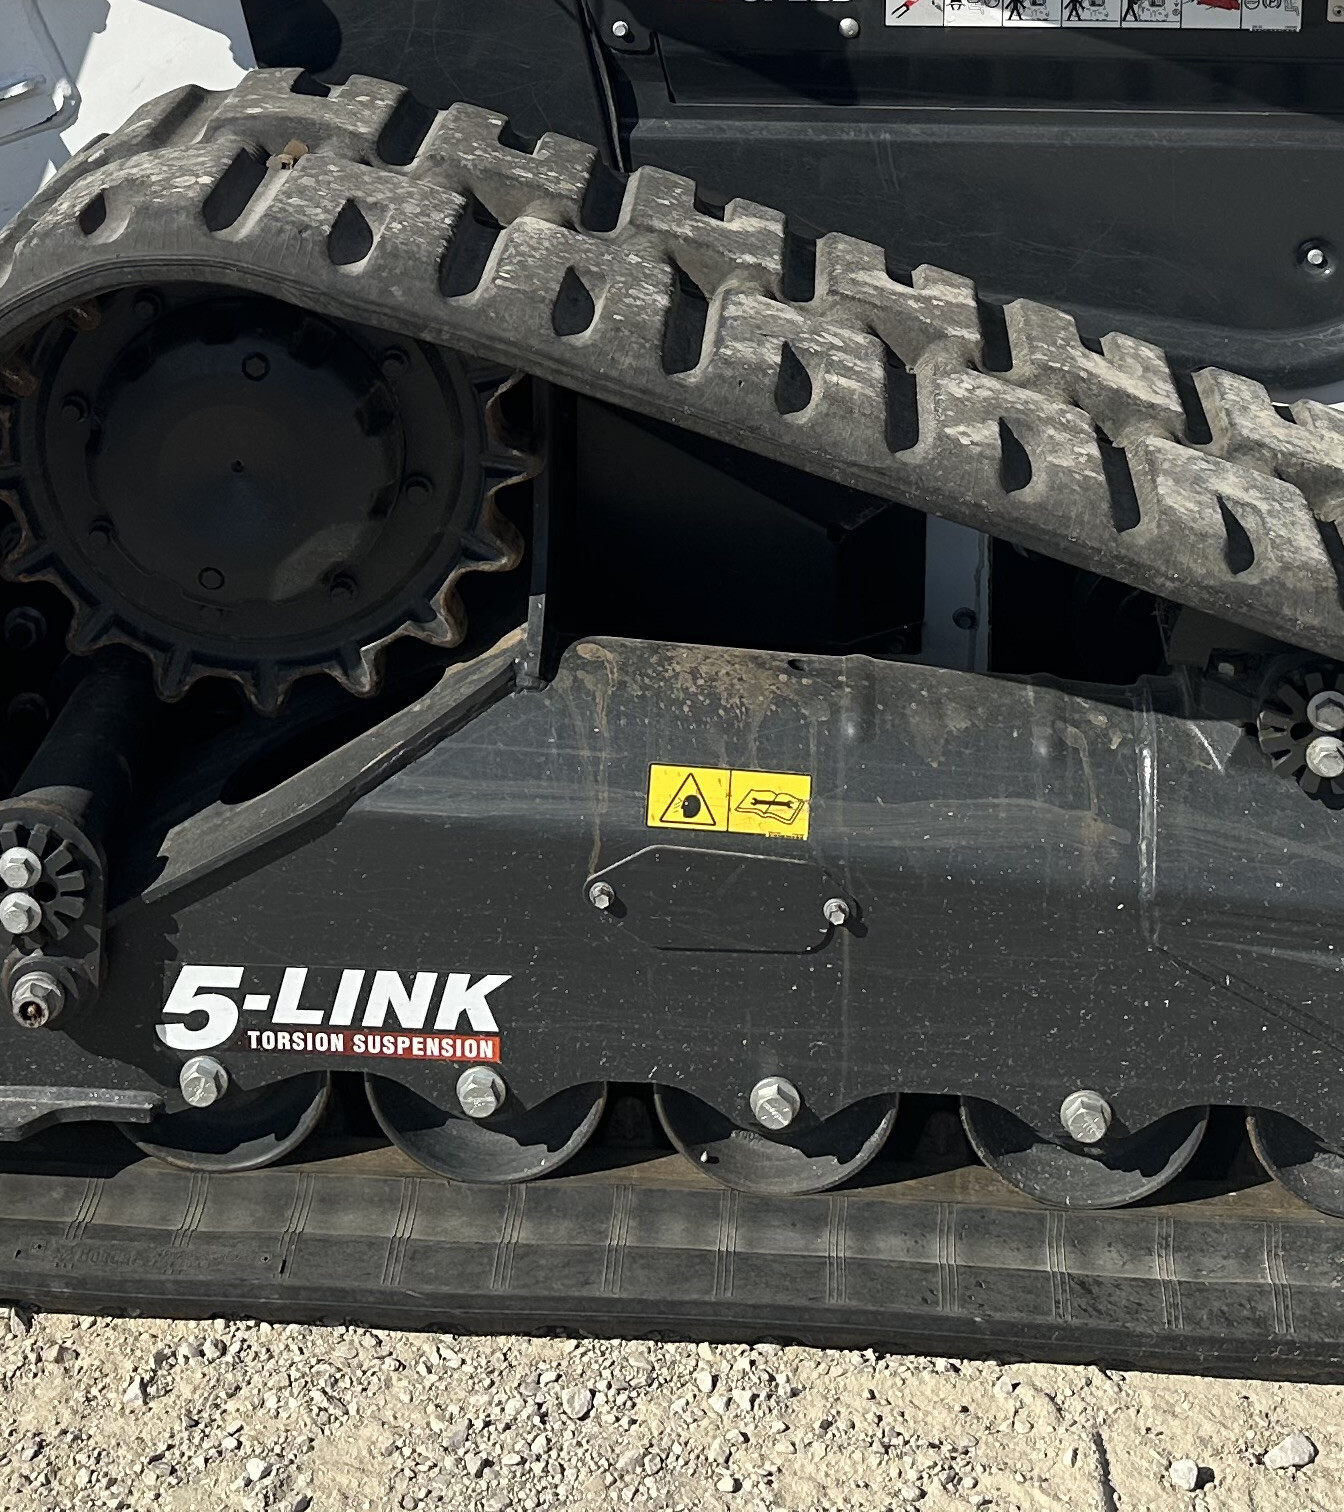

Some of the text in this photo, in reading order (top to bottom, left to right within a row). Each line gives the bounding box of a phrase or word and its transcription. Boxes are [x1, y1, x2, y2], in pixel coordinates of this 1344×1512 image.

[155, 964, 513, 1051] 5-LINK
[247, 1030, 494, 1059] TORSION SUSPENSION
